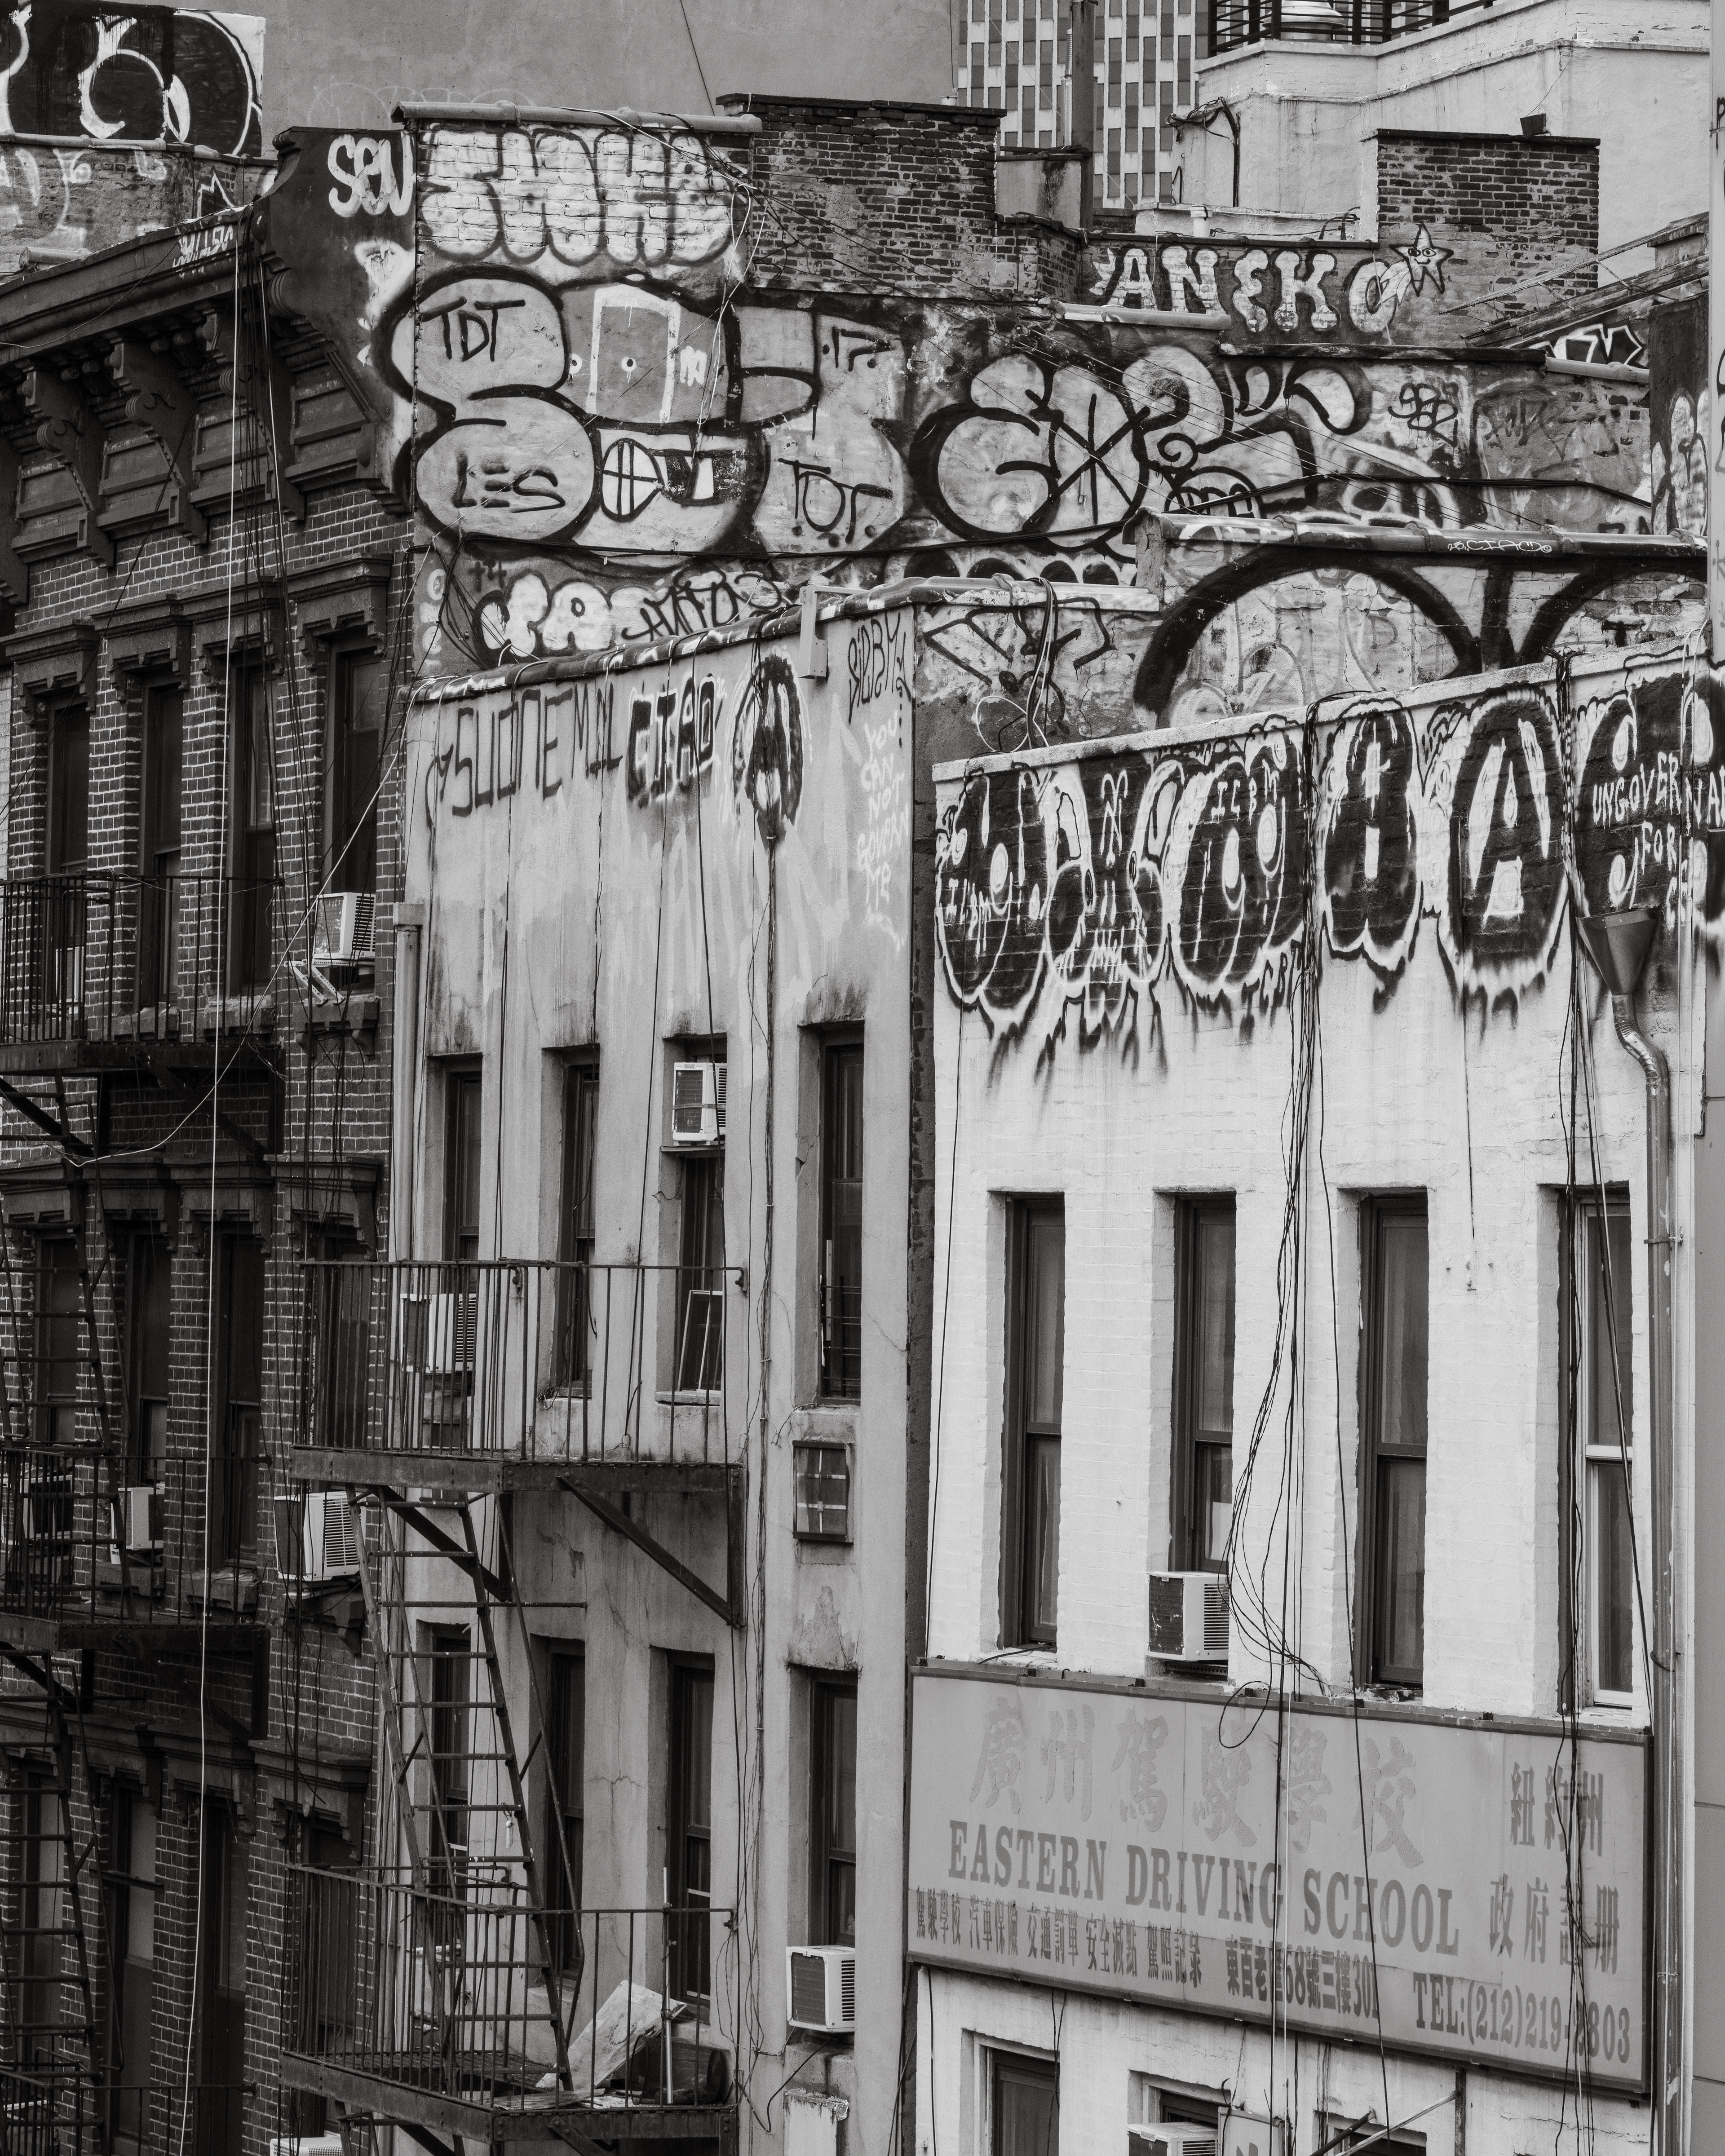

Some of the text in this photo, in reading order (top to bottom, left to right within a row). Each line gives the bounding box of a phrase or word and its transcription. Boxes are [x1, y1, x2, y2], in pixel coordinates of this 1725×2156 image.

[420, 296, 526, 363] TDT
[1593, 751, 1725, 835] UNGOVERNA
[1641, 821, 1677, 875] FOR
[948, 1820, 1460, 1957] EASTERN DRIVING SCHOOL
